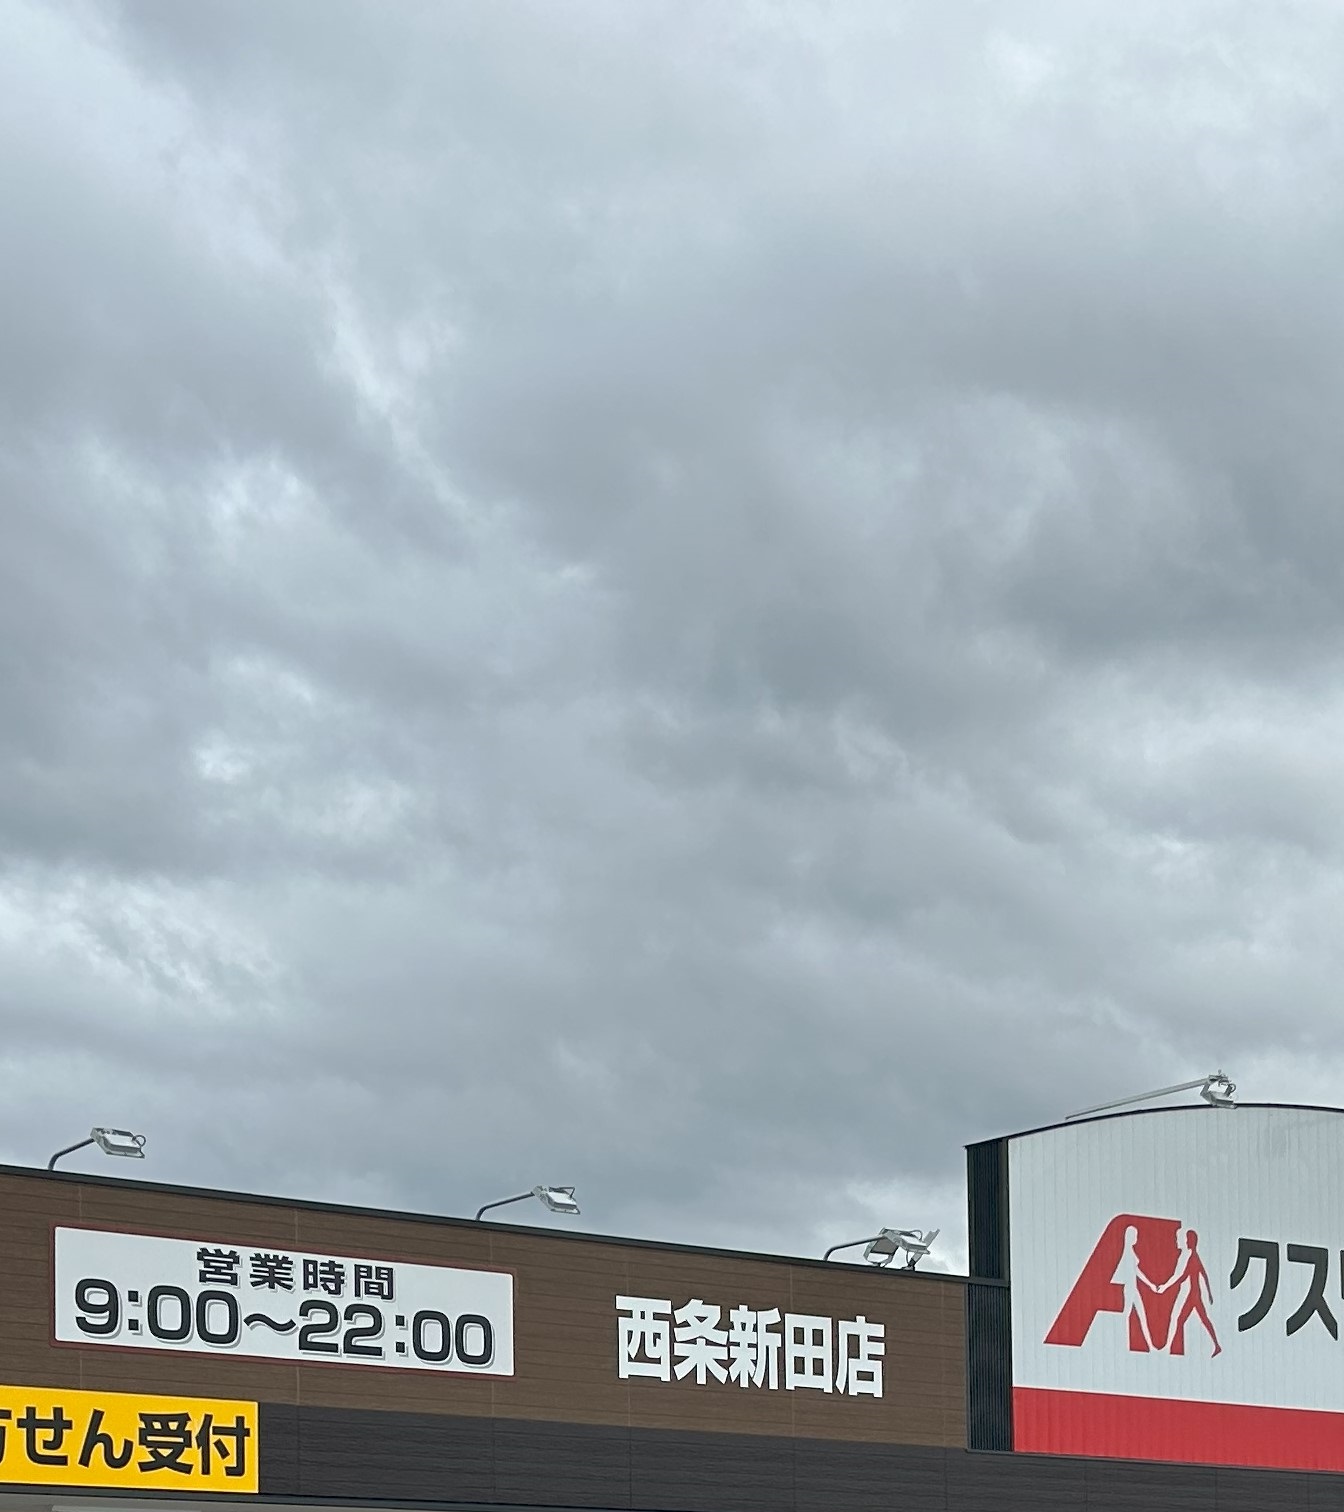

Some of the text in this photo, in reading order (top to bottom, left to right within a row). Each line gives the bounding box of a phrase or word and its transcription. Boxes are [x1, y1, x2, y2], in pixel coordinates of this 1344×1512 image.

[197, 1246, 396, 1301] 営業時間
[615, 1295, 884, 1398] 西条新田店
